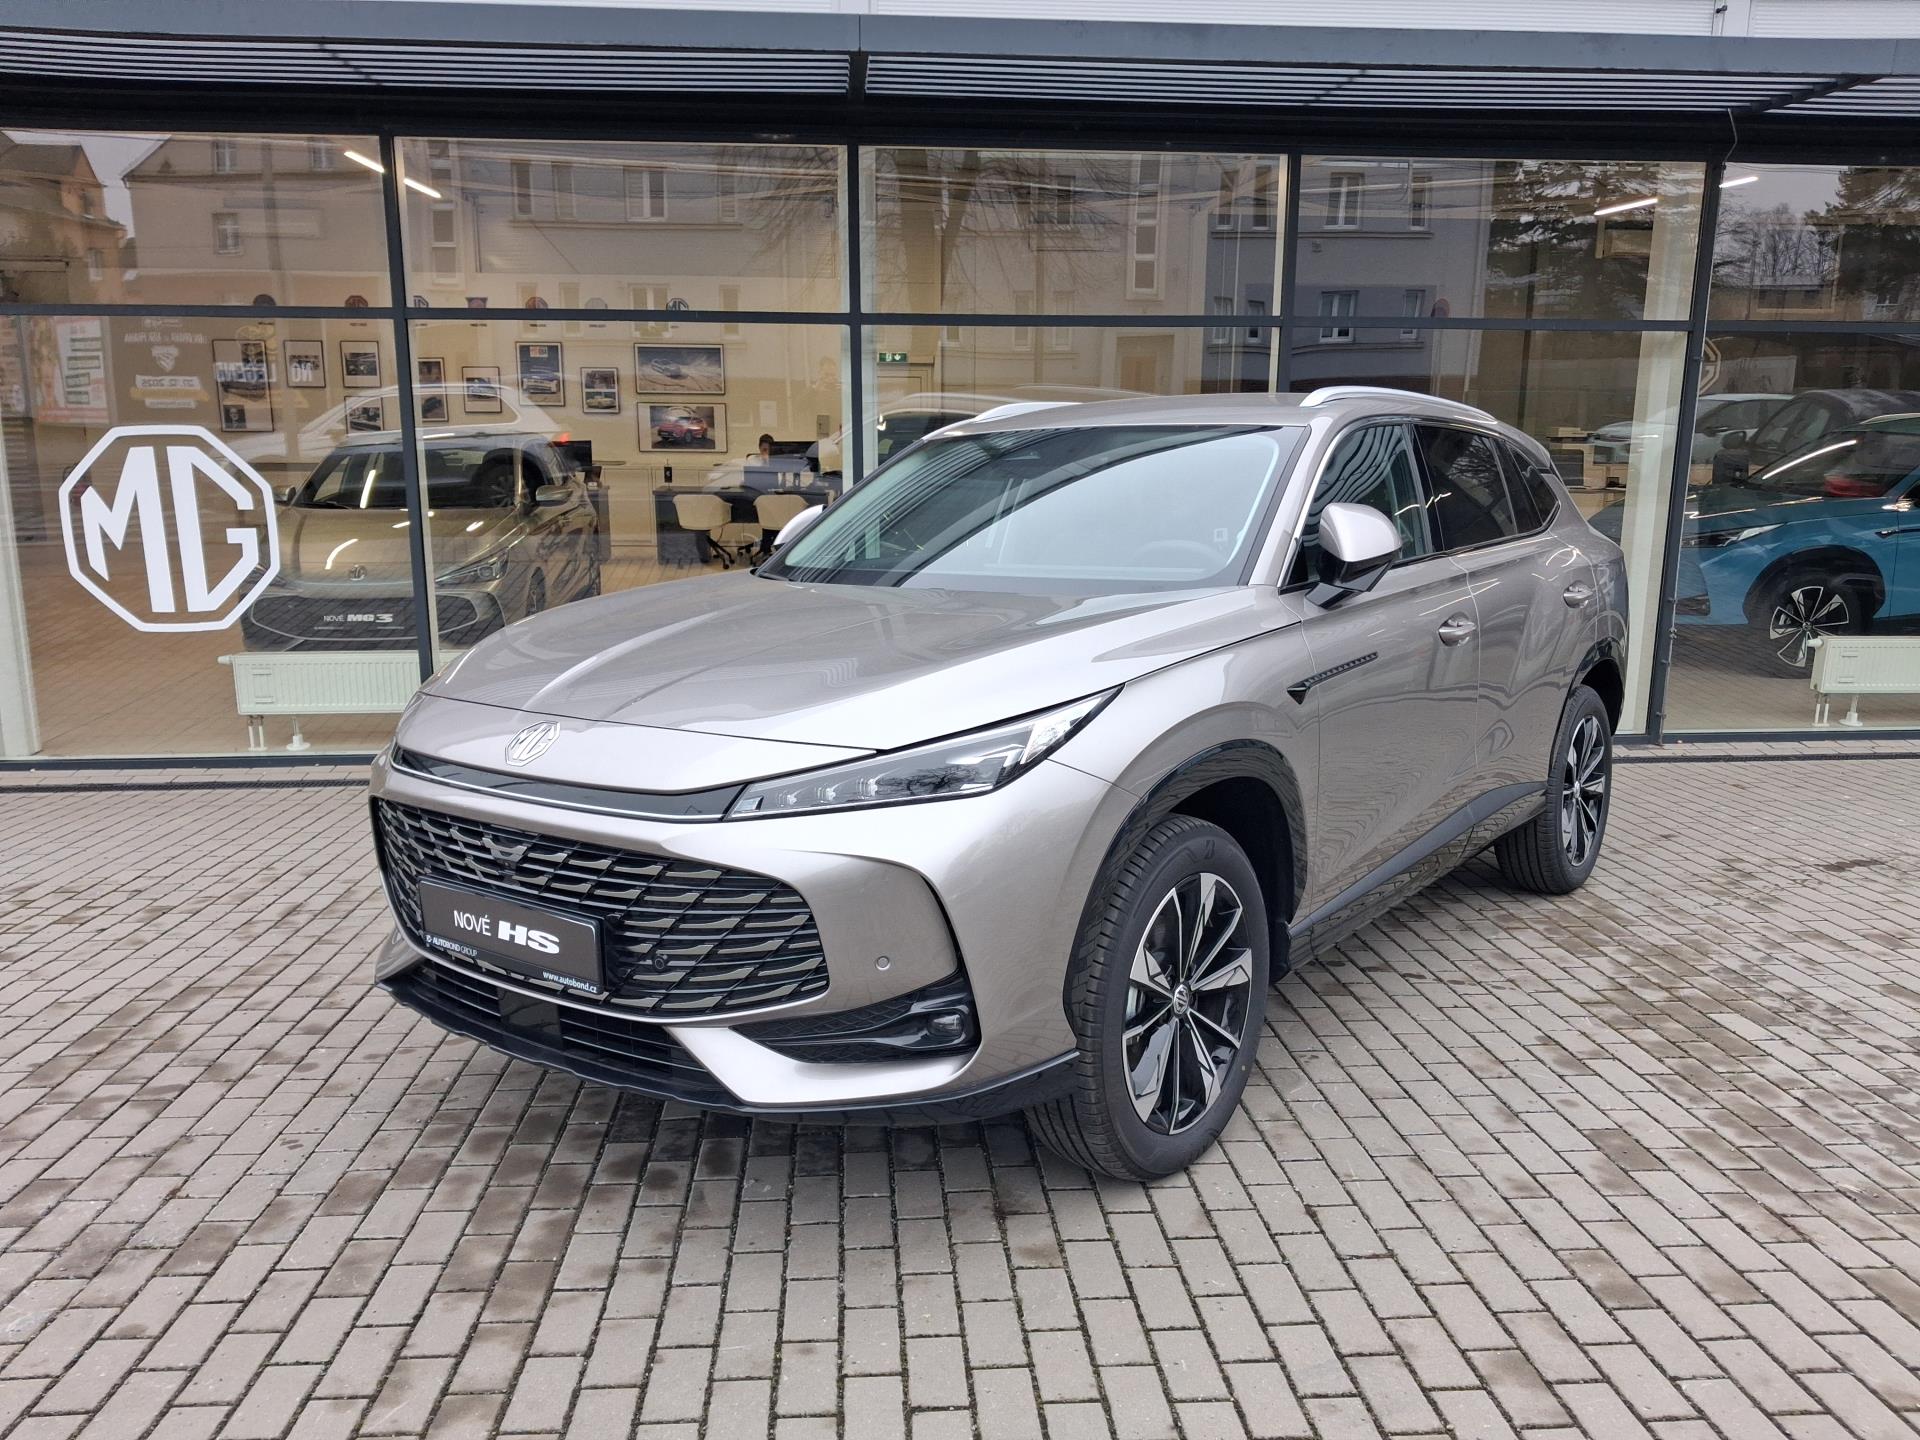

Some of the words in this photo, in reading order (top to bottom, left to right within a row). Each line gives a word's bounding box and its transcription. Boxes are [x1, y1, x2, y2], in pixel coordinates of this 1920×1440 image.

[81, 446, 259, 613] MG
[323, 614, 345, 622] NOVÉ
[509, 723, 556, 762] MG
[432, 937, 460, 951] AUTOBOND
[460, 945, 477, 956] GROUP
[453, 910, 491, 936] NOVÉ
[498, 920, 560, 954] HS
[542, 970, 597, 993] www.autobond.cz
